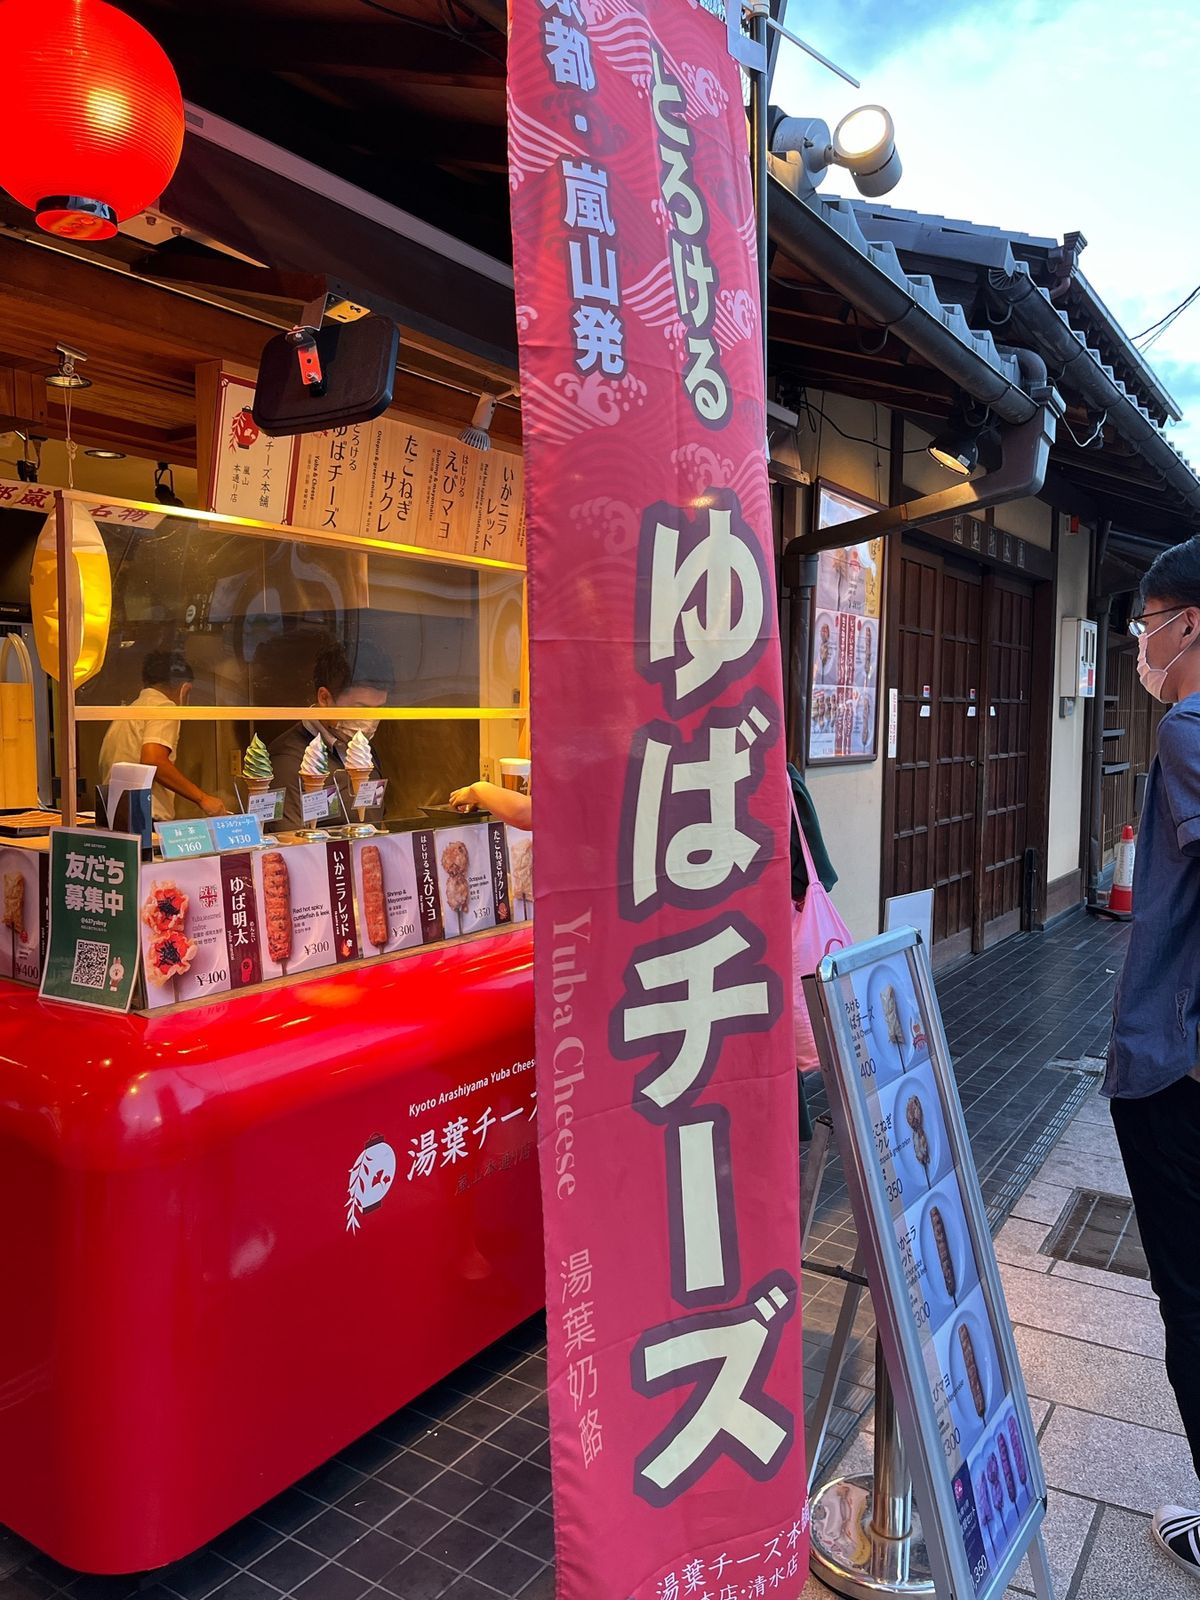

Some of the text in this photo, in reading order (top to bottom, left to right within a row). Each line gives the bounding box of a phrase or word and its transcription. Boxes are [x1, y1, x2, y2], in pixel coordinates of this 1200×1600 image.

[650, 45, 730, 421] とろける
[230, 463, 241, 503] 本通り店
[242, 465, 250, 486] 嵐山
[377, 470, 397, 533] サクレ
[396, 434, 418, 521] たこねぎ
[437, 450, 458, 539] えびマヨ
[458, 454, 469, 498] はじける
[497, 466, 514, 536] いかニラ
[482, 498, 498, 551] レッド
[177, 841, 202, 854] ¥160
[228, 834, 251, 845] ¥130
[493, 830, 505, 900] たこねぎサクレ
[65, 851, 125, 885] 友だち
[333, 850, 350, 937] いかニラレッド
[64, 883, 124, 917] 募集中
[230, 876, 249, 947] ゆば明太
[304, 941, 330, 956] ¥300
[392, 924, 415, 938] ¥300
[16, 962, 39, 980] ¥400
[196, 969, 227, 987] ¥400
[623, 508, 788, 1489] ゆばチーズ
[552, 906, 593, 1200] Yuba Cheese
[408, 1058, 536, 1118] Kyoto Arashiyama Yuba Chees
[872, 1113, 892, 1139] こねぎ
[560, 1248, 603, 1469] 湯葉奶酪
